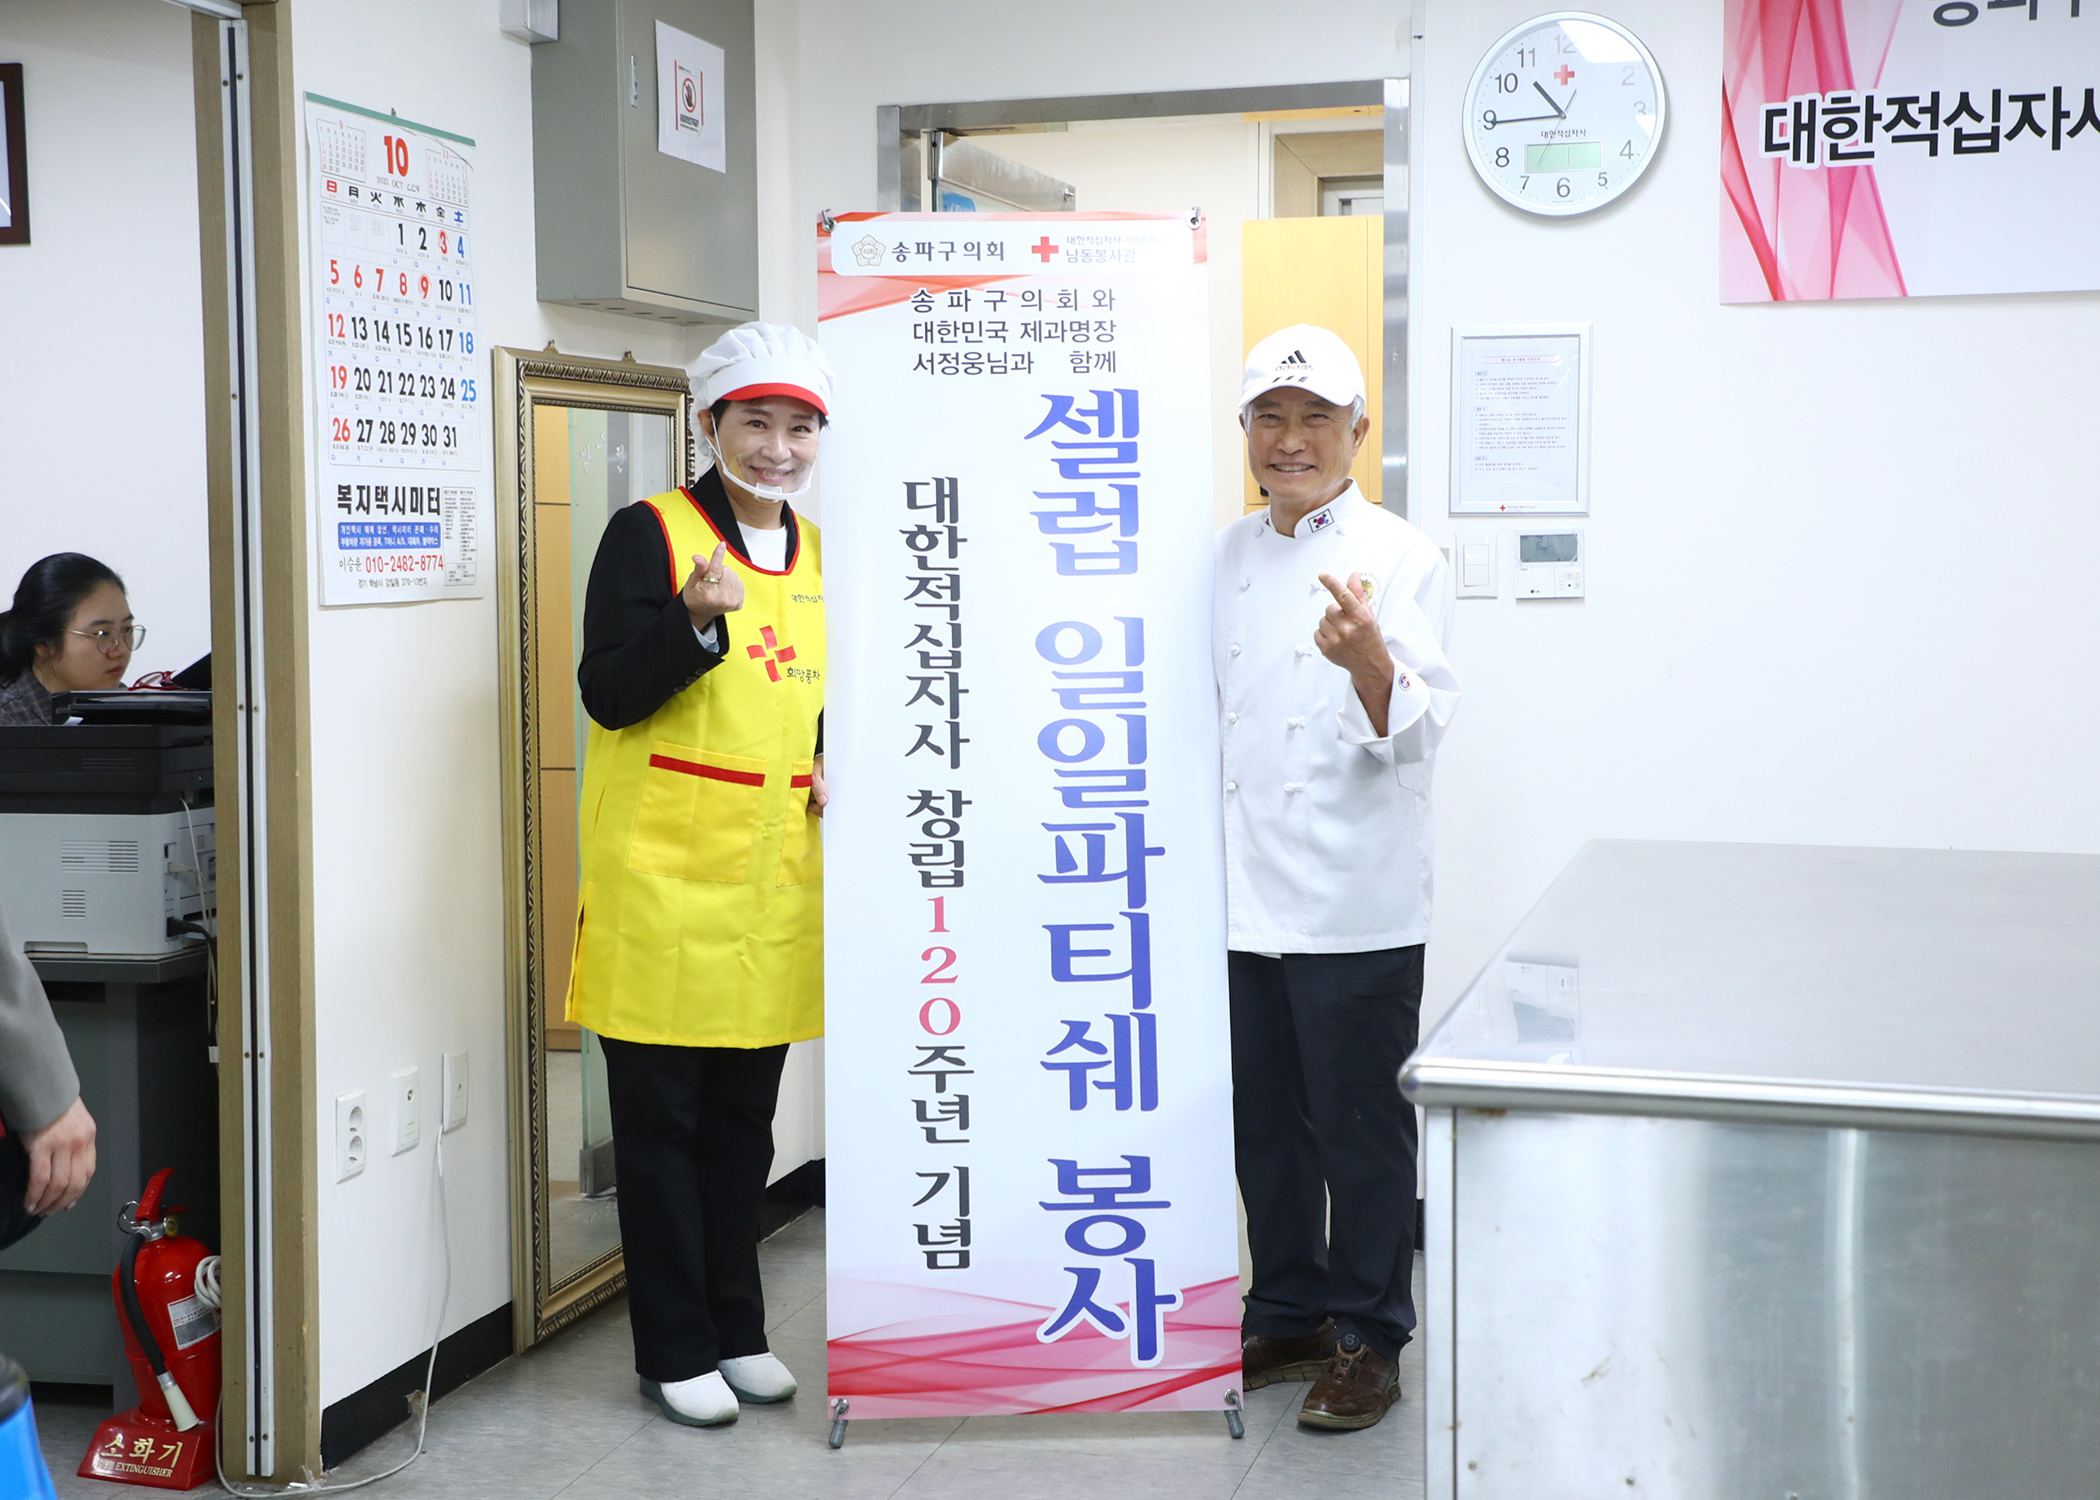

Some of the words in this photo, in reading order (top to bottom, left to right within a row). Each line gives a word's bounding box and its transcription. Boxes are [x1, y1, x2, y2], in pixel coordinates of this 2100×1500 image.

[1517, 47, 1536, 68] 11
[1494, 72, 1518, 94] 10
[1621, 66, 1636, 86] 2
[1483, 110, 1497, 130] 9
[1540, 128, 1586, 139] 대한적십자사
[384, 136, 409, 177] 10
[1495, 147, 1510, 168] 8
[1619, 139, 1634, 160] 4
[376, 176, 389, 186] 2025
[392, 180, 404, 189] OCT
[1520, 176, 1530, 190] 7
[1556, 177, 1570, 197] 6
[1597, 172, 1608, 186] 5
[327, 180, 337, 193] 日
[349, 186, 359, 198] 月
[370, 192, 382, 204] 火
[393, 196, 405, 208] 水
[436, 206, 445, 218] 金
[454, 211, 464, 223] 土
[398, 223, 404, 245] 1
[419, 227, 427, 250] 2
[440, 231, 447, 254] 3
[458, 236, 464, 258] 4
[1066, 235, 1121, 246] 대한적십자사
[891, 241, 1006, 263] 송파구의회
[1066, 248, 1136, 263] 남동봉사관
[330, 259, 339, 285] 5
[354, 264, 363, 288] 6
[376, 268, 384, 292] 7
[400, 272, 407, 296] 8
[421, 276, 429, 299] 9
[439, 279, 452, 302] 10
[459, 283, 471, 305] 11
[328, 314, 345, 338] 12
[352, 316, 368, 341] 13
[374, 320, 390, 344] 14
[396, 323, 412, 347] 15
[418, 326, 433, 350] 16
[439, 329, 453, 352] 17
[460, 332, 474, 354] 18
[912, 320, 1009, 344] 대한민국
[1020, 319, 1117, 344] 제과명장
[912, 352, 1035, 376] 서정웅님과
[1069, 351, 1117, 374] 함께
[331, 365, 347, 389] 19
[354, 367, 371, 391] 20
[378, 369, 392, 393] 21
[399, 372, 415, 396] 22
[420, 374, 435, 398] 23
[440, 377, 455, 400] 24
[461, 379, 476, 402] 25
[333, 417, 351, 442] 26
[356, 419, 374, 443] 27
[380, 421, 396, 445] 28
[401, 422, 416, 445] 29
[422, 424, 437, 447] 30
[443, 425, 457, 448] 31
[1023, 388, 1141, 576] 셀럽
[337, 484, 440, 516] 복지택시미터
[365, 555, 444, 573] 010-2482-8774
[899, 476, 970, 770] 대한적십자사
[787, 667, 820, 684] 희망풍차
[1035, 616, 1166, 1112] 일일파티쉐
[912, 1166, 971, 1270] 기념
[1039, 1154, 1177, 1362] 봉사
[100, 1436, 183, 1468] 소화기
[116, 1462, 173, 1478] EXTINGUISHER
